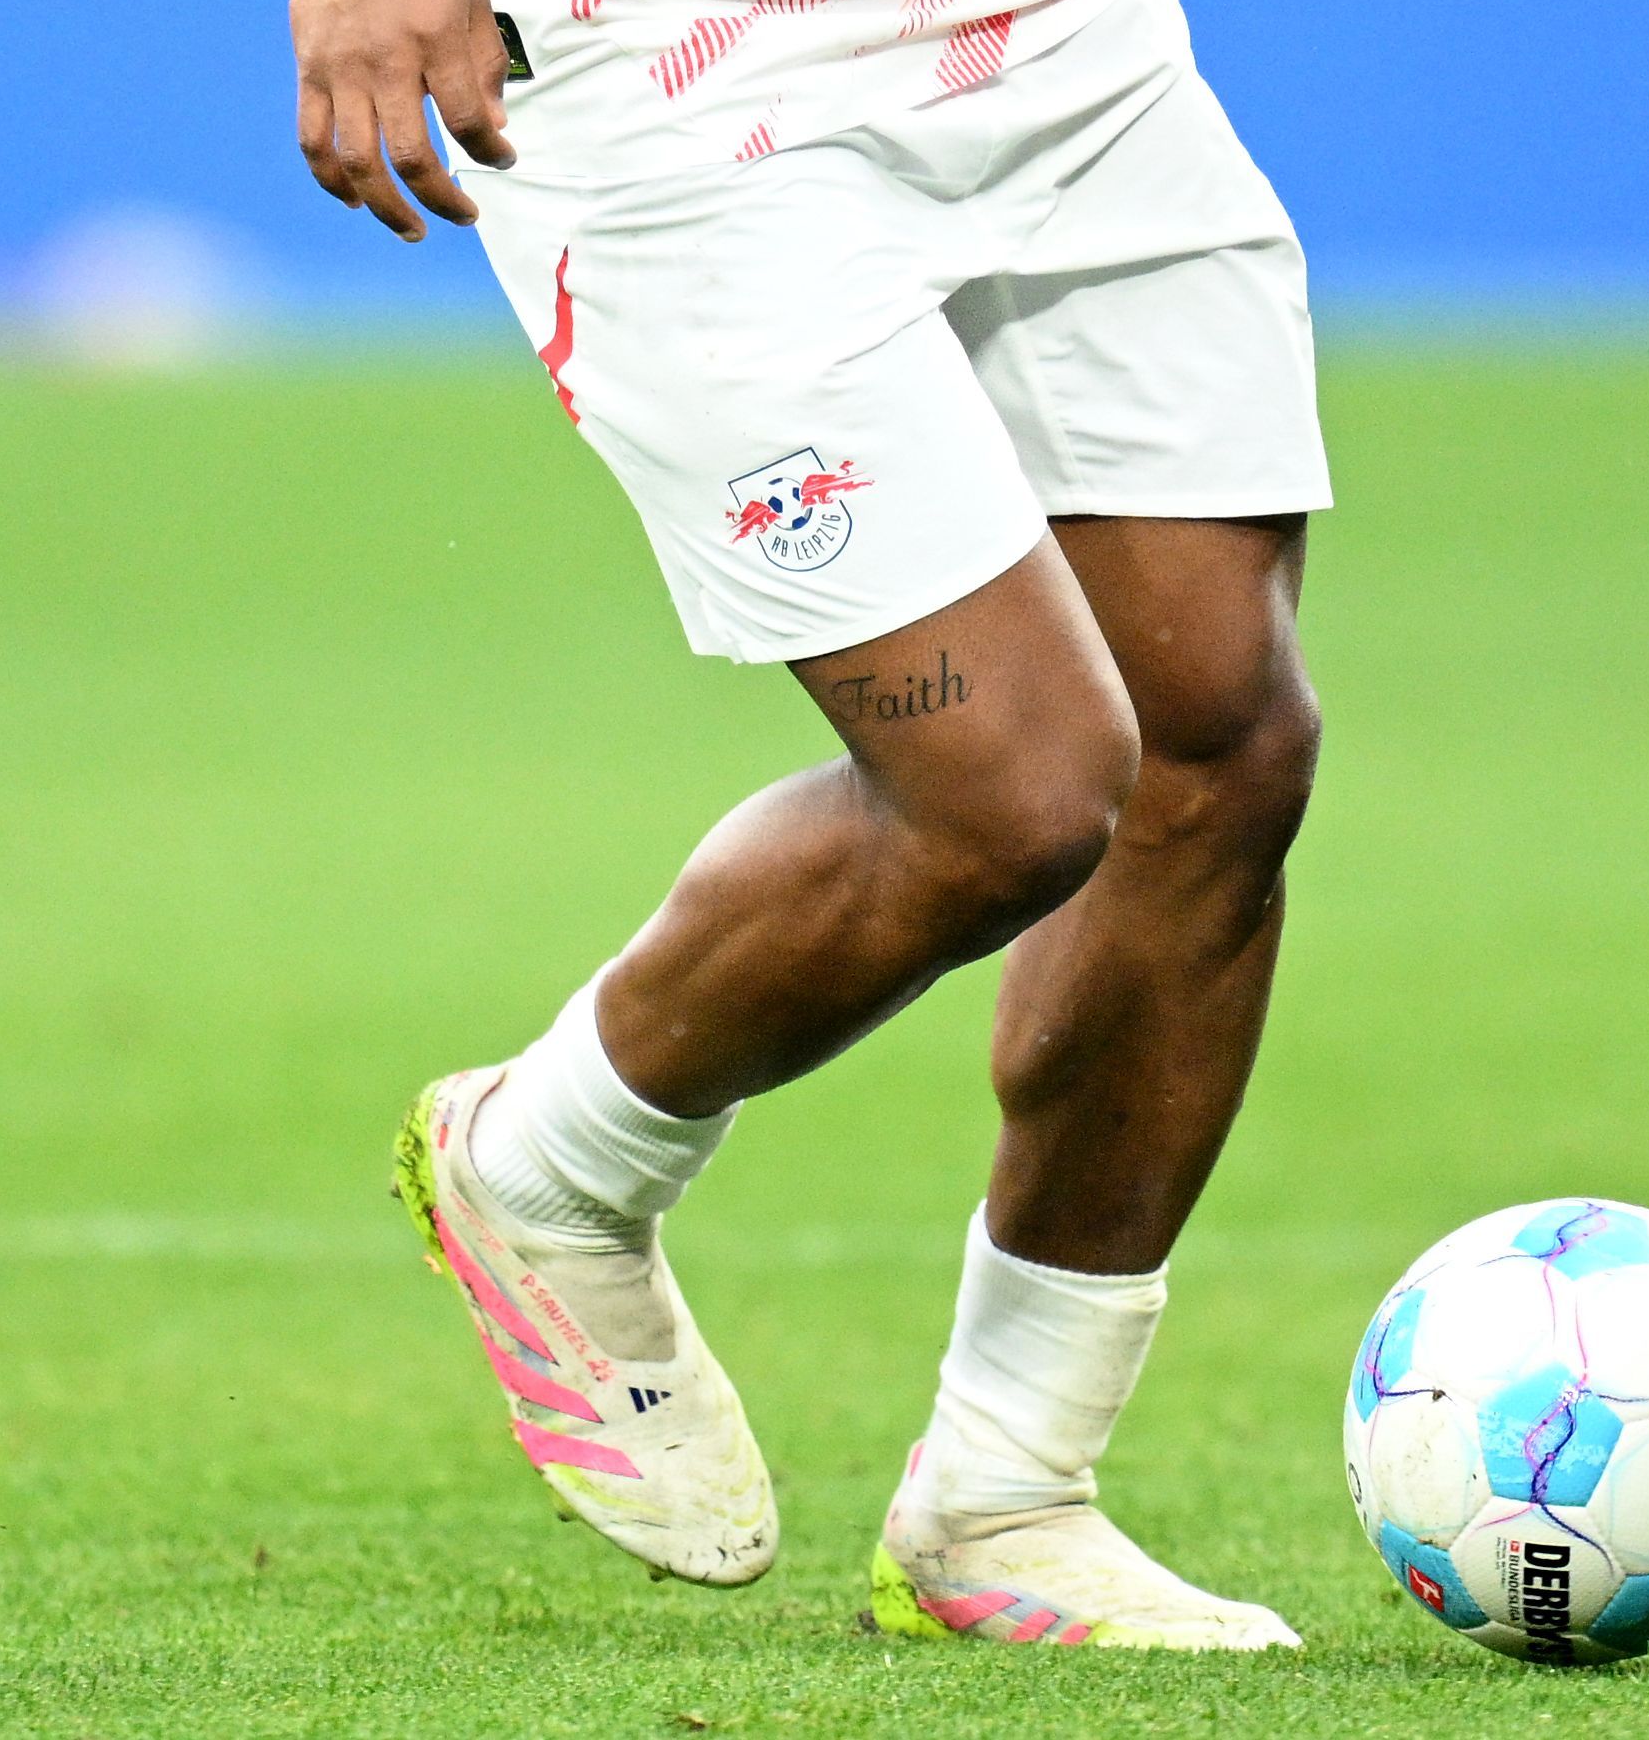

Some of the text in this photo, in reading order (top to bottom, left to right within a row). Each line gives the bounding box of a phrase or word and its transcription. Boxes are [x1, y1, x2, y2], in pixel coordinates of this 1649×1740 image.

[771, 513, 841, 560] RB LEIPZIG
[831, 650, 973, 722] Faith
[519, 1273, 590, 1355] PSAUMES
[1508, 1554, 1520, 1621] BUNDESLIGA
